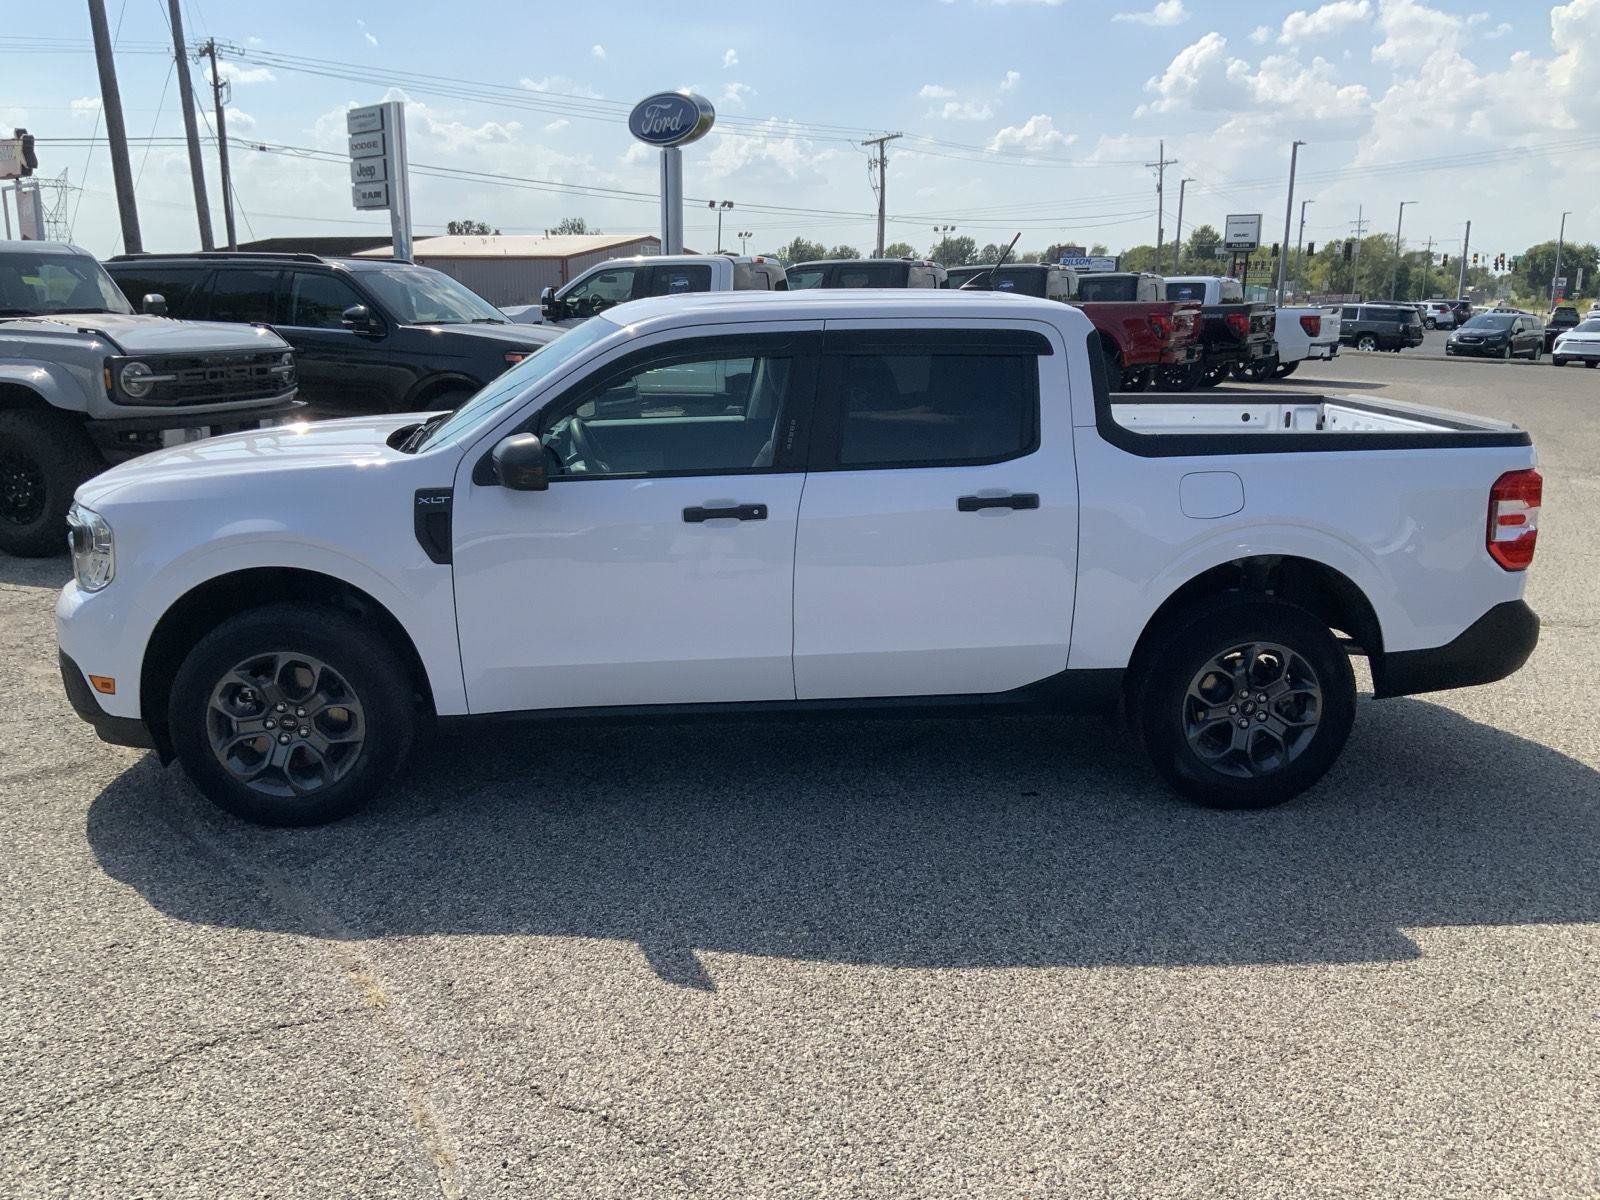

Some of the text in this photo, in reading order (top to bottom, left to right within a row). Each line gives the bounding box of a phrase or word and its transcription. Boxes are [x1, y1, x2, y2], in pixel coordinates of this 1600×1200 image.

[641, 103, 683, 134] Ford
[351, 141, 378, 151] DODGE
[356, 163, 375, 179] Jeep
[418, 496, 451, 504] XLT
